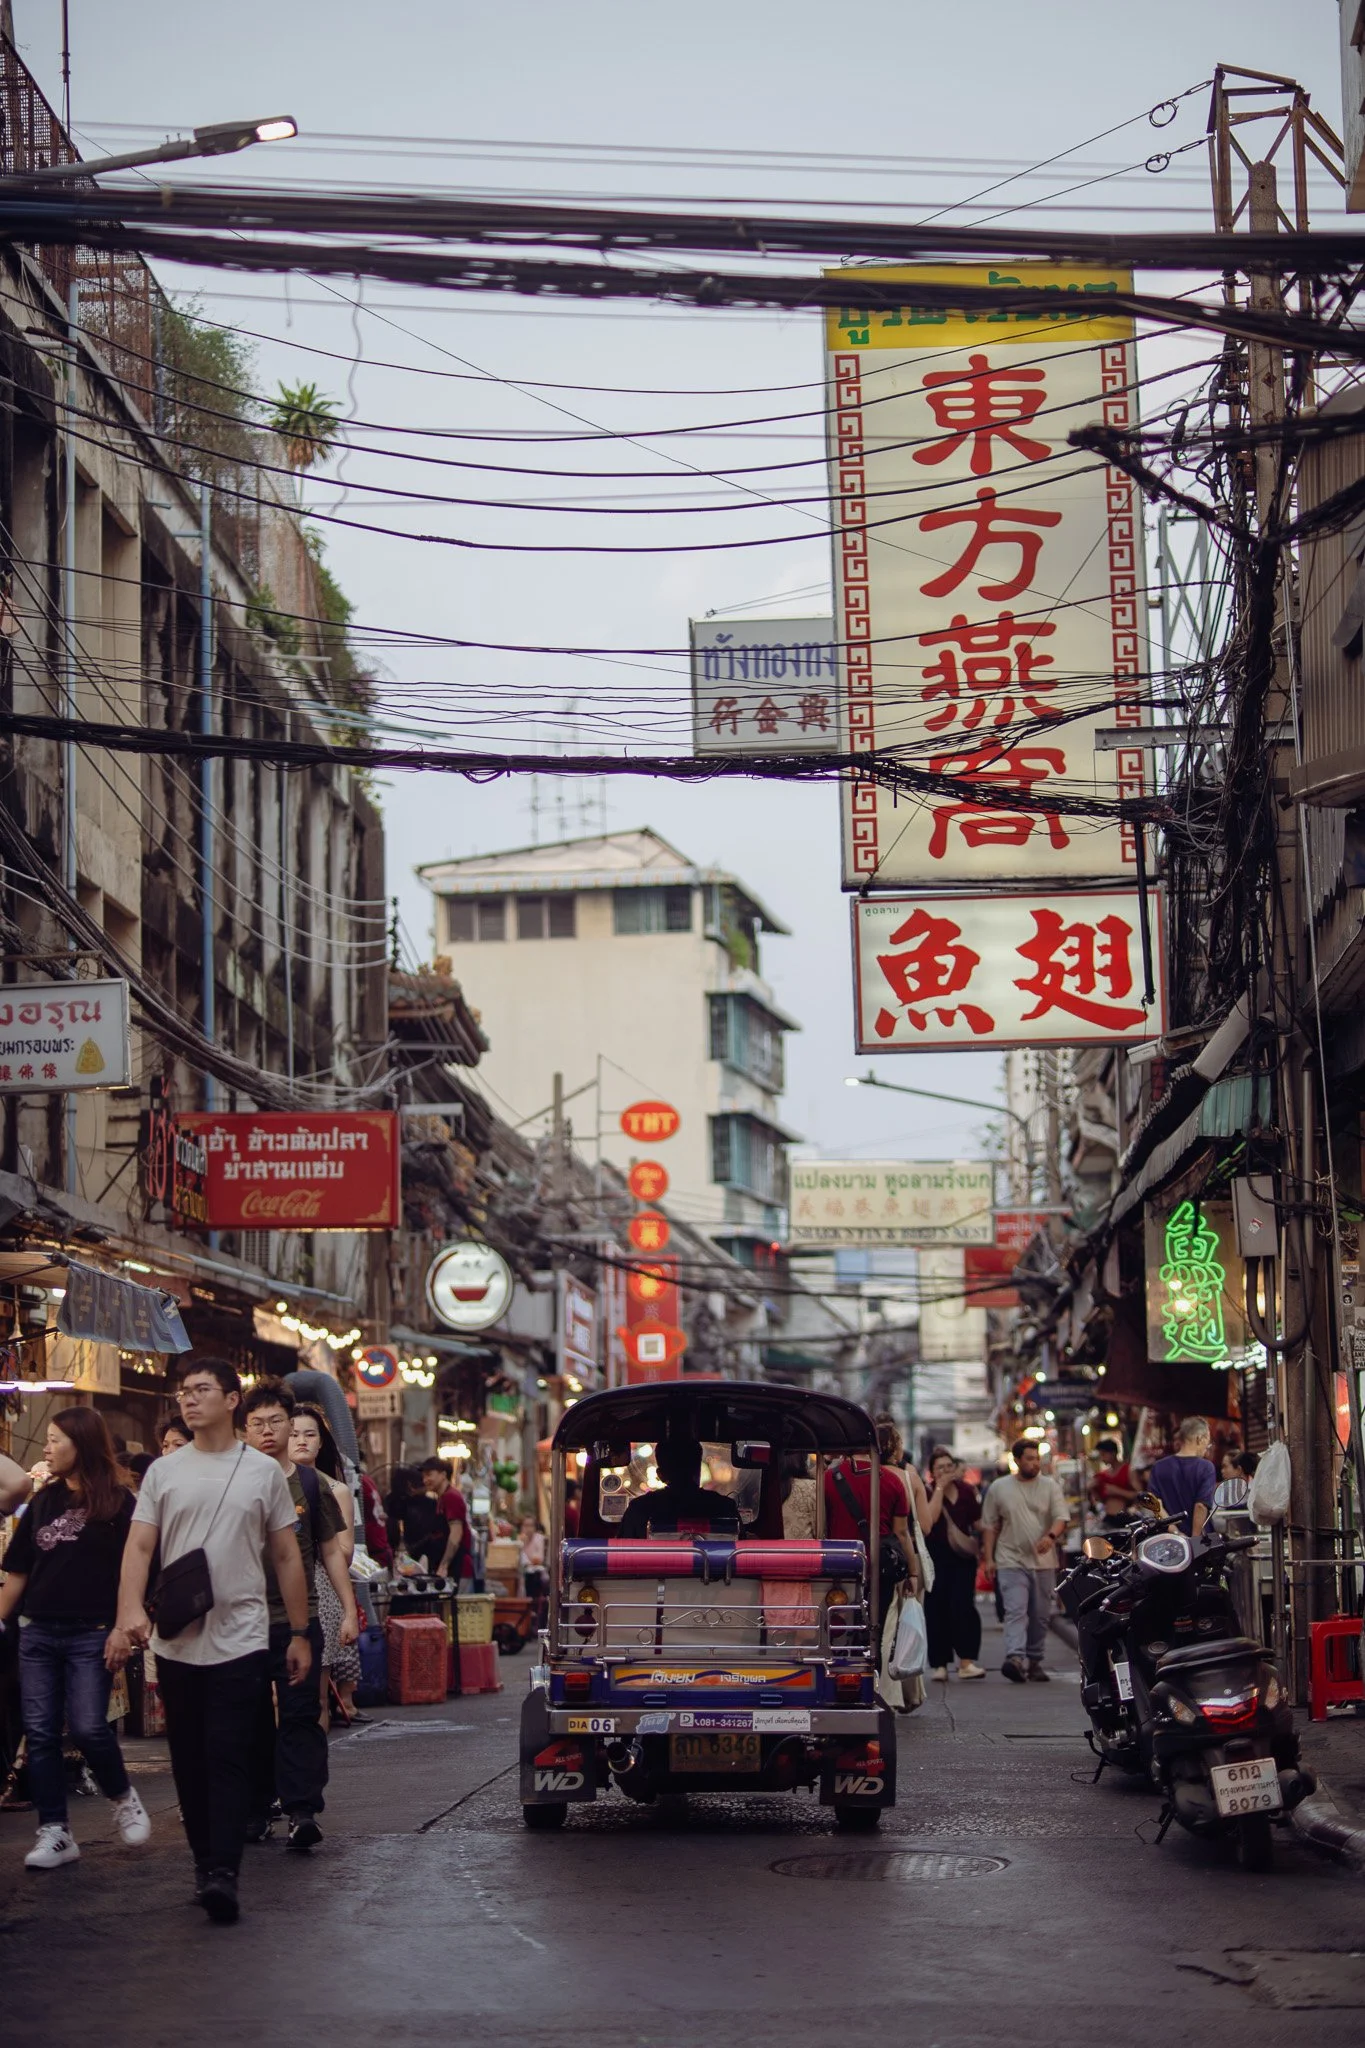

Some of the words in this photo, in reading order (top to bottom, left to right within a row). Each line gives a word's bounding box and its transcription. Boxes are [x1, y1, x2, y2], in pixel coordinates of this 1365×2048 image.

[874, 908, 1148, 1038] 魚翅
[248, 1126, 369, 1152] ข้าวต้มปลา
[569, 1721, 588, 1730] DIA
[591, 1719, 611, 1732] 06
[534, 1772, 584, 1791] WD
[834, 1776, 884, 1794] WD
[1229, 1794, 1271, 1812] 8079
